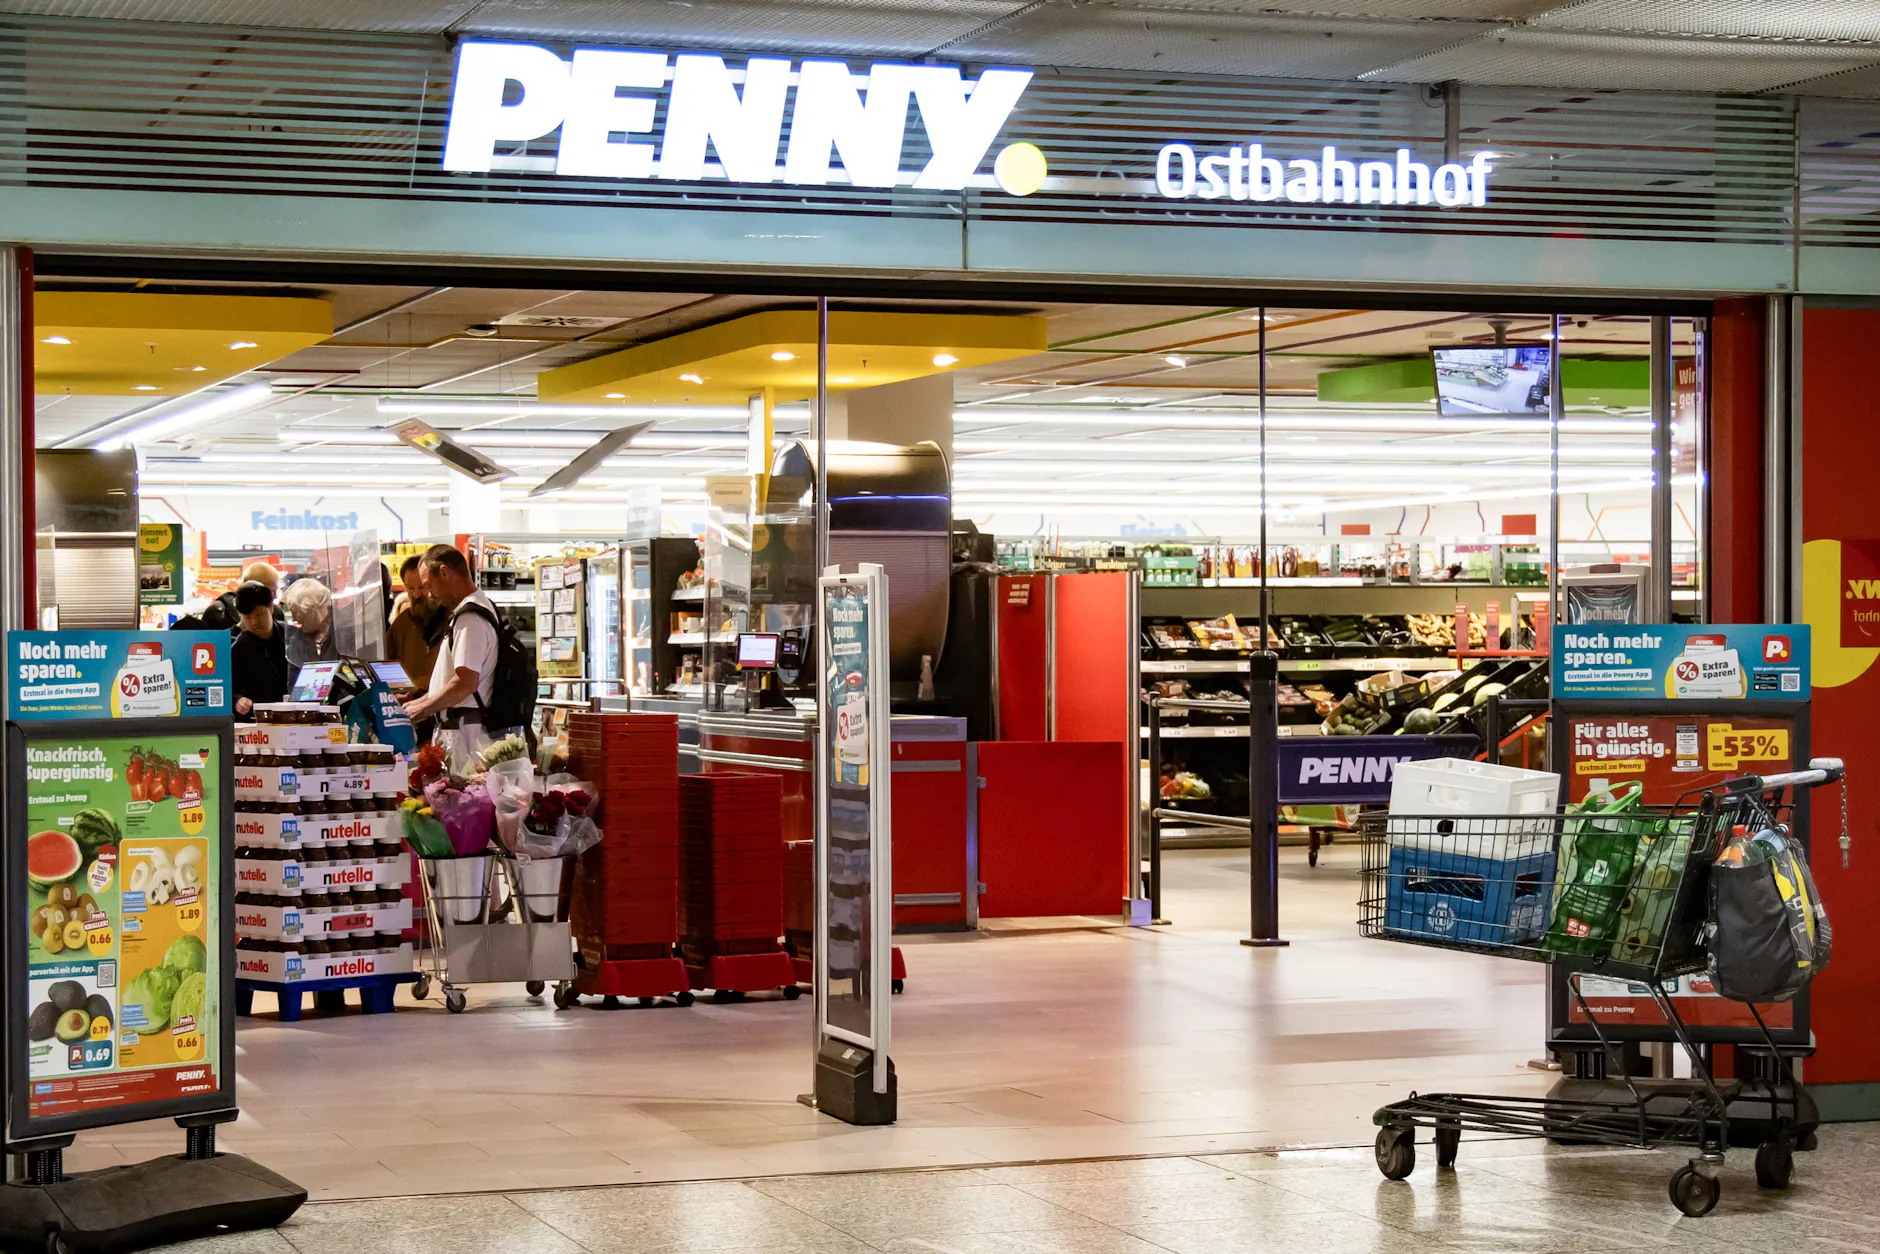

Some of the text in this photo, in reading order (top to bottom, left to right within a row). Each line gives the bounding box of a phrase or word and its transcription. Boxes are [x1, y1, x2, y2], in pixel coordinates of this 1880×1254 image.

[443, 39, 1047, 195] PENNY.
[1156, 143, 1495, 206] Ostbahnhof
[252, 508, 358, 530] Feinkost
[833, 608, 848, 622] Noch
[834, 627, 856, 641] sparen.
[1565, 633, 1662, 648] Noch mehr
[20, 641, 108, 659] Noch mehr
[1564, 653, 1632, 668] sparen.
[1702, 662, 1729, 671] Extra
[20, 664, 82, 683] sparen.
[143, 674, 165, 684] Extra
[1703, 668, 1736, 679] sparen!
[144, 681, 172, 694] sparen!
[1575, 722, 1648, 738] Für alles
[239, 731, 269, 745] nutella
[1575, 740, 1593, 756] in
[1596, 738, 1671, 759] günstig.
[1713, 736, 1779, 757] -53%
[27, 746, 107, 762] Knackfrisch.
[27, 763, 118, 783] Supergünstig.
[1619, 763, 1642, 771] Penny
[235, 776, 263, 788] nutella
[282, 776, 296, 785] 1kg
[344, 781, 363, 789] 4.89
[29, 795, 55, 804] Erstmal
[66, 794, 87, 802] Penny
[183, 813, 203, 823] 1.89
[236, 822, 264, 835] nutella
[283, 822, 296, 832] 1kg
[321, 822, 371, 839] nutella
[239, 869, 267, 881] nutella
[286, 868, 299, 878] 1kg
[324, 867, 373, 885] nutella
[180, 909, 200, 919] 1.89
[239, 914, 267, 927] nutella
[286, 915, 299, 925] 1kg
[90, 934, 111, 944] 0.66
[30, 968, 60, 977] parvorteil
[60, 966, 70, 974] mit
[240, 960, 268, 973] nutella
[288, 960, 301, 971] 1kg
[325, 958, 375, 977] nutella
[1613, 1006, 1635, 1014] Penny
[93, 1026, 109, 1034] 0.79
[178, 1038, 197, 1048] 0.66
[86, 1048, 110, 1062] 0.69
[176, 1070, 205, 1082] PENNY.
